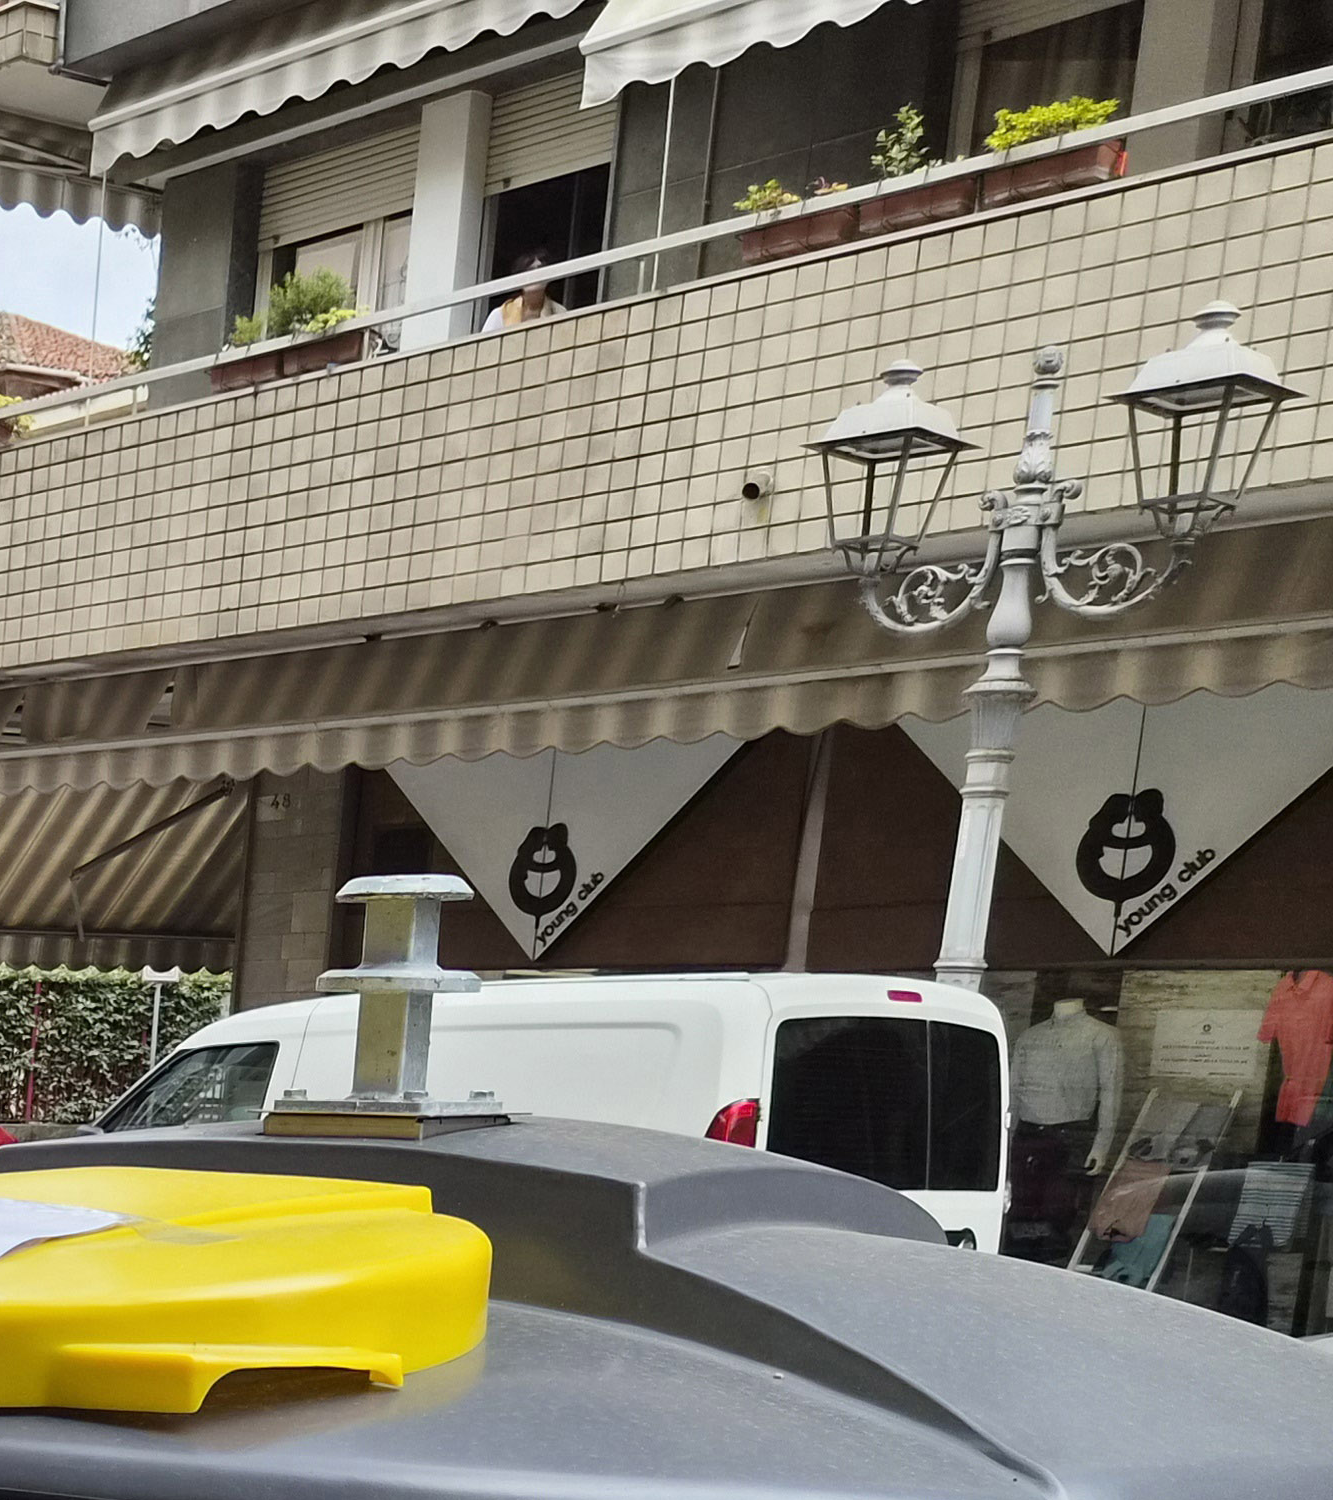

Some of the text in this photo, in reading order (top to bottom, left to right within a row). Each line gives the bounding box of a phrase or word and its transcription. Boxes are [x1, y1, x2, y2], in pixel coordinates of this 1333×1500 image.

[536, 872, 605, 946] young club
[1117, 849, 1216, 937] young club
